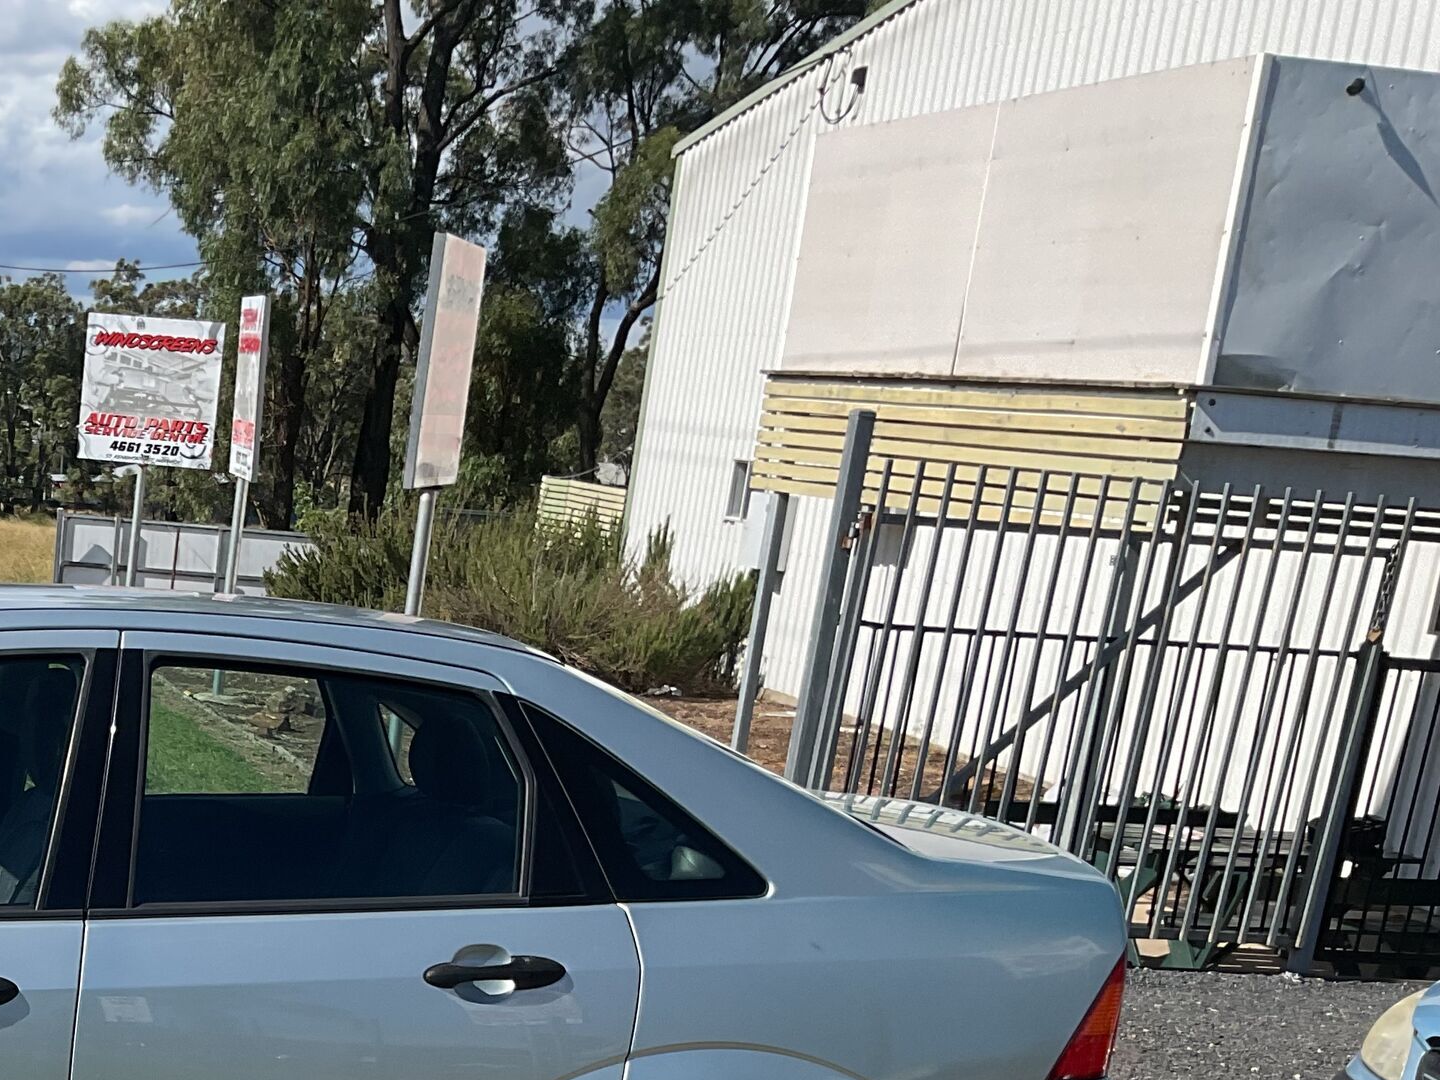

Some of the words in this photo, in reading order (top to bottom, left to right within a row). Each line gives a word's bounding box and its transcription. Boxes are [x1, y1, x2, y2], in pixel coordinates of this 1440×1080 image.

[95, 331, 218, 354] WINDSCREENS
[83, 424, 146, 440] SERVICE
[84, 412, 139, 429] AUTO
[144, 418, 210, 435] PARTS
[109, 440, 141, 454] 4661
[143, 443, 180, 457] 3520
